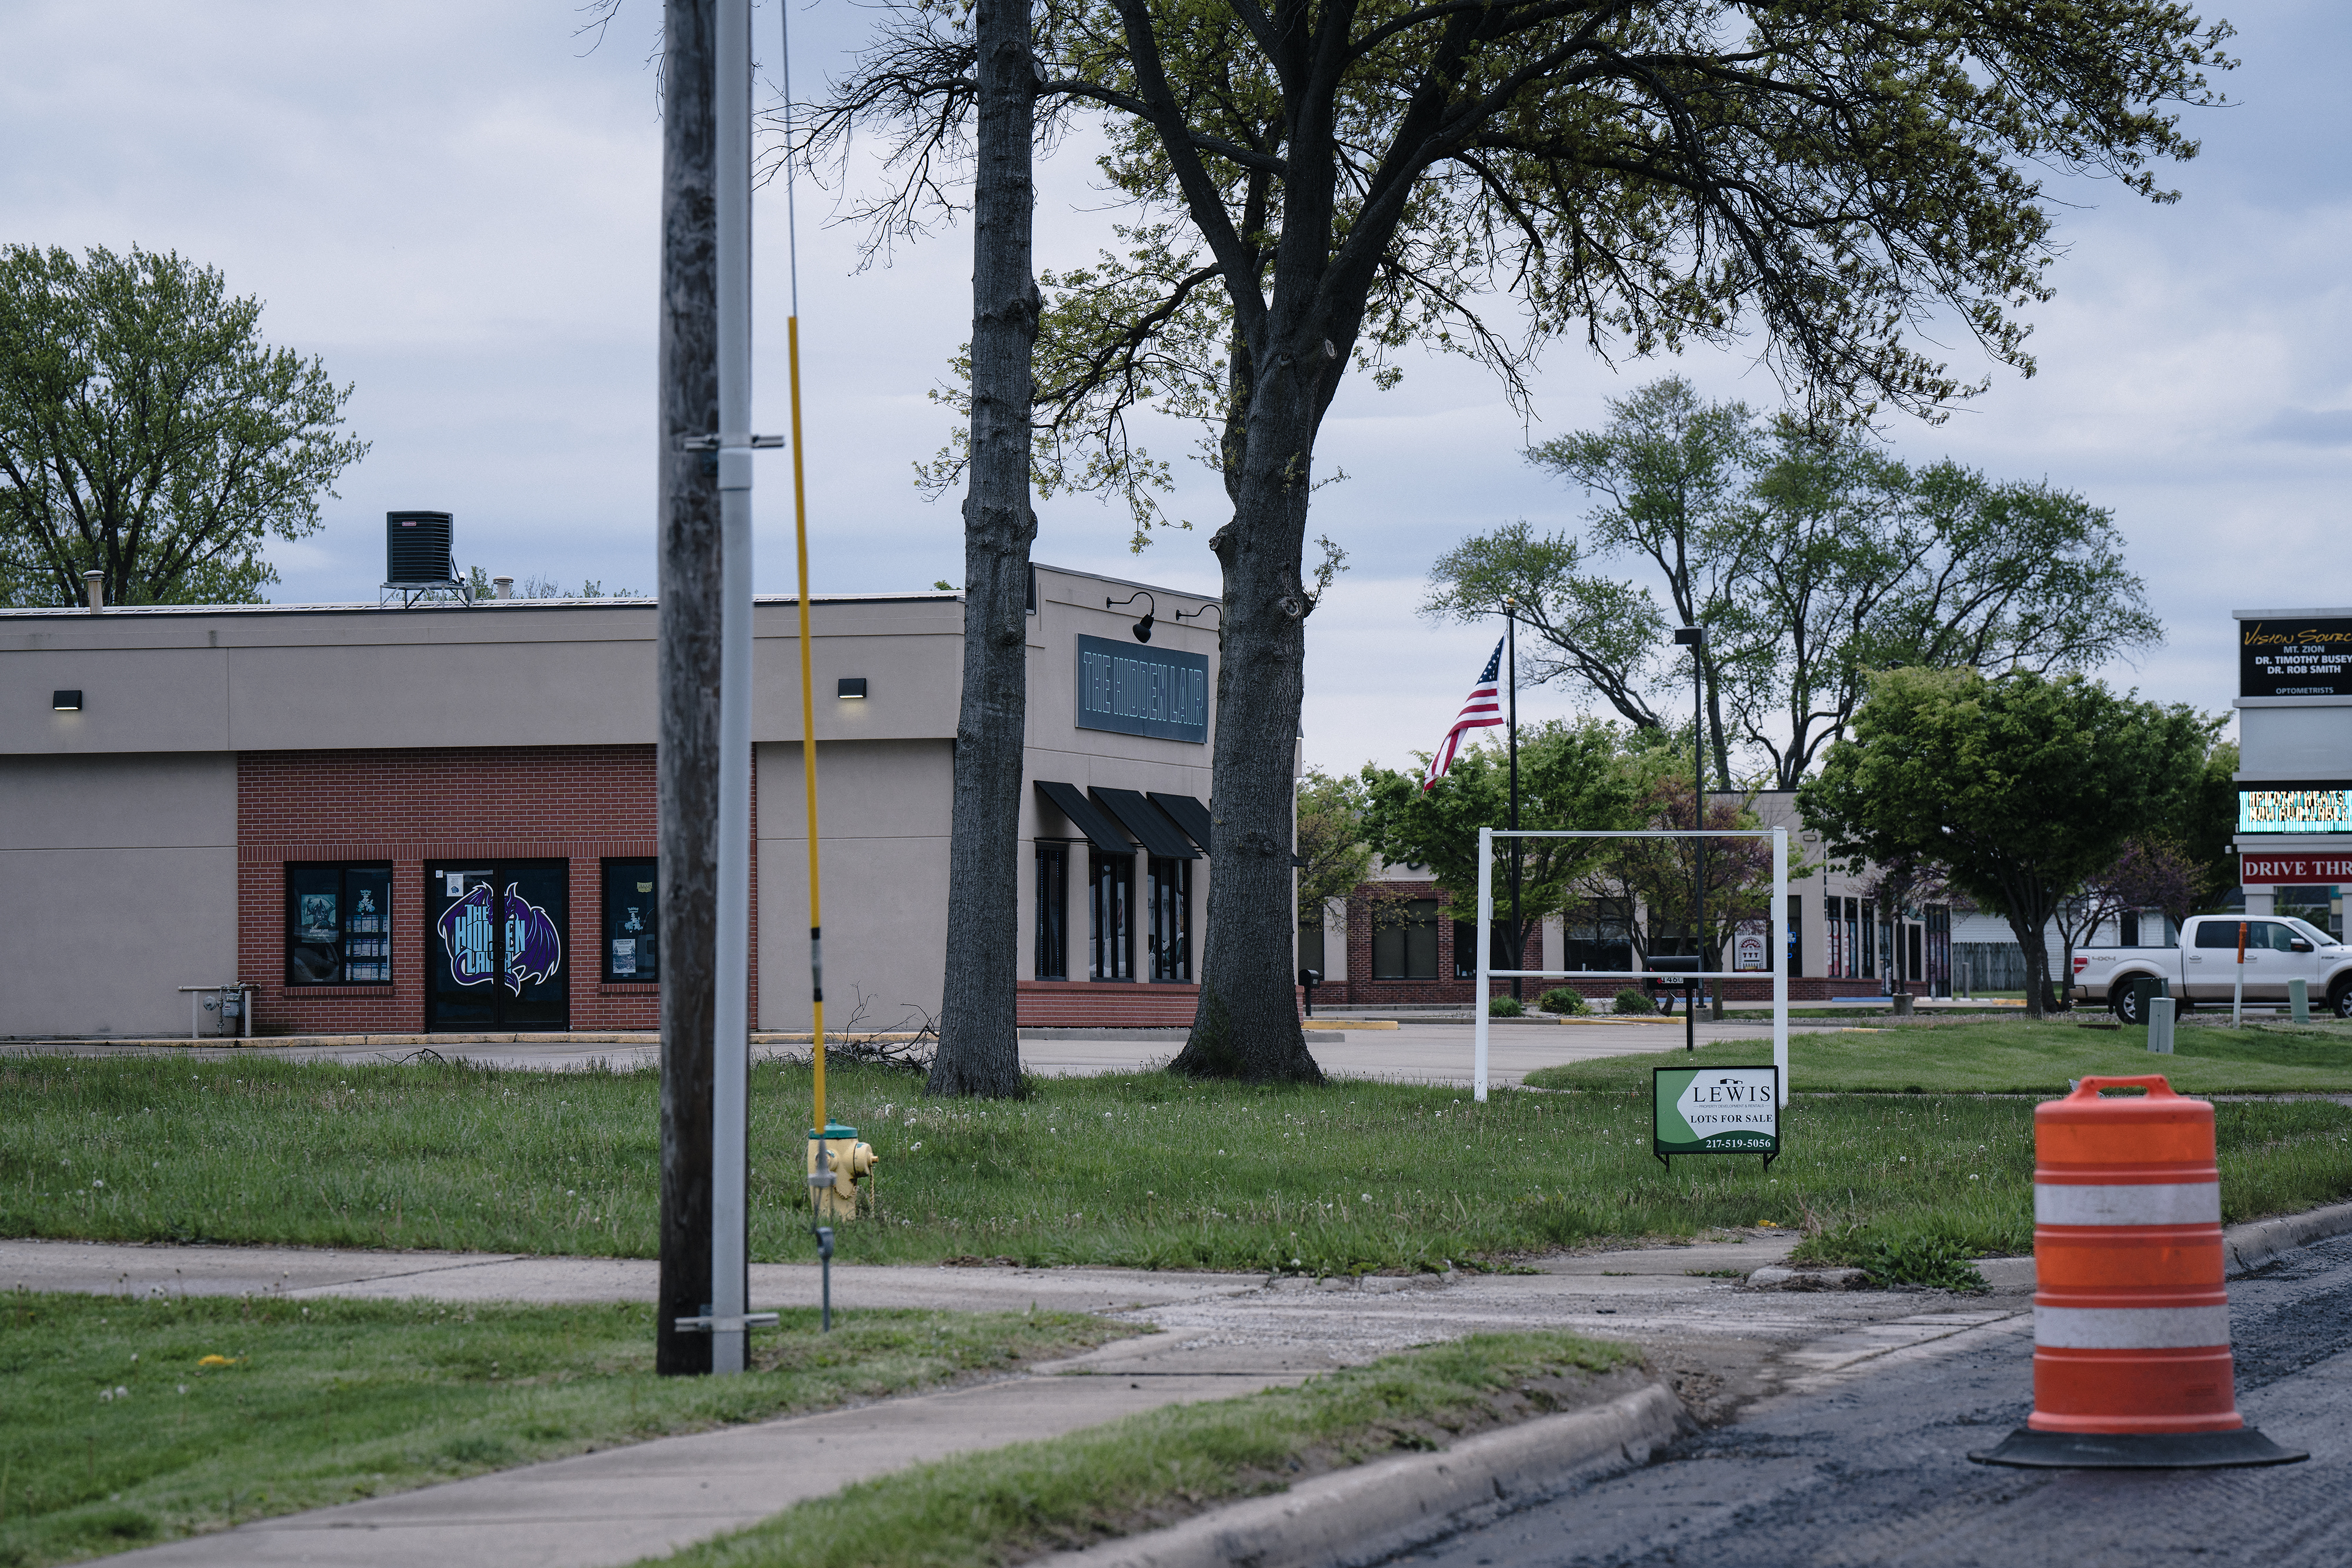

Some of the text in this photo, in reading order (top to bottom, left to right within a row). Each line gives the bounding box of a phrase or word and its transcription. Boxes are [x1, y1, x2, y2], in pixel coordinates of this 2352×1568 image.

[2297, 629, 2352, 644] SOURC
[2275, 656, 2319, 664] TIMOTHY
[2321, 654, 2352, 663] BUSEY
[2310, 665, 2341, 673] SMITH
[1084, 652, 1203, 726] THE HIDDEN LAIR
[2245, 862, 2307, 876] DRIVE
[465, 904, 489, 926] THE
[1693, 1086, 1770, 1102] LEWIS
[1706, 1139, 1770, 1148] 217-519-5056
